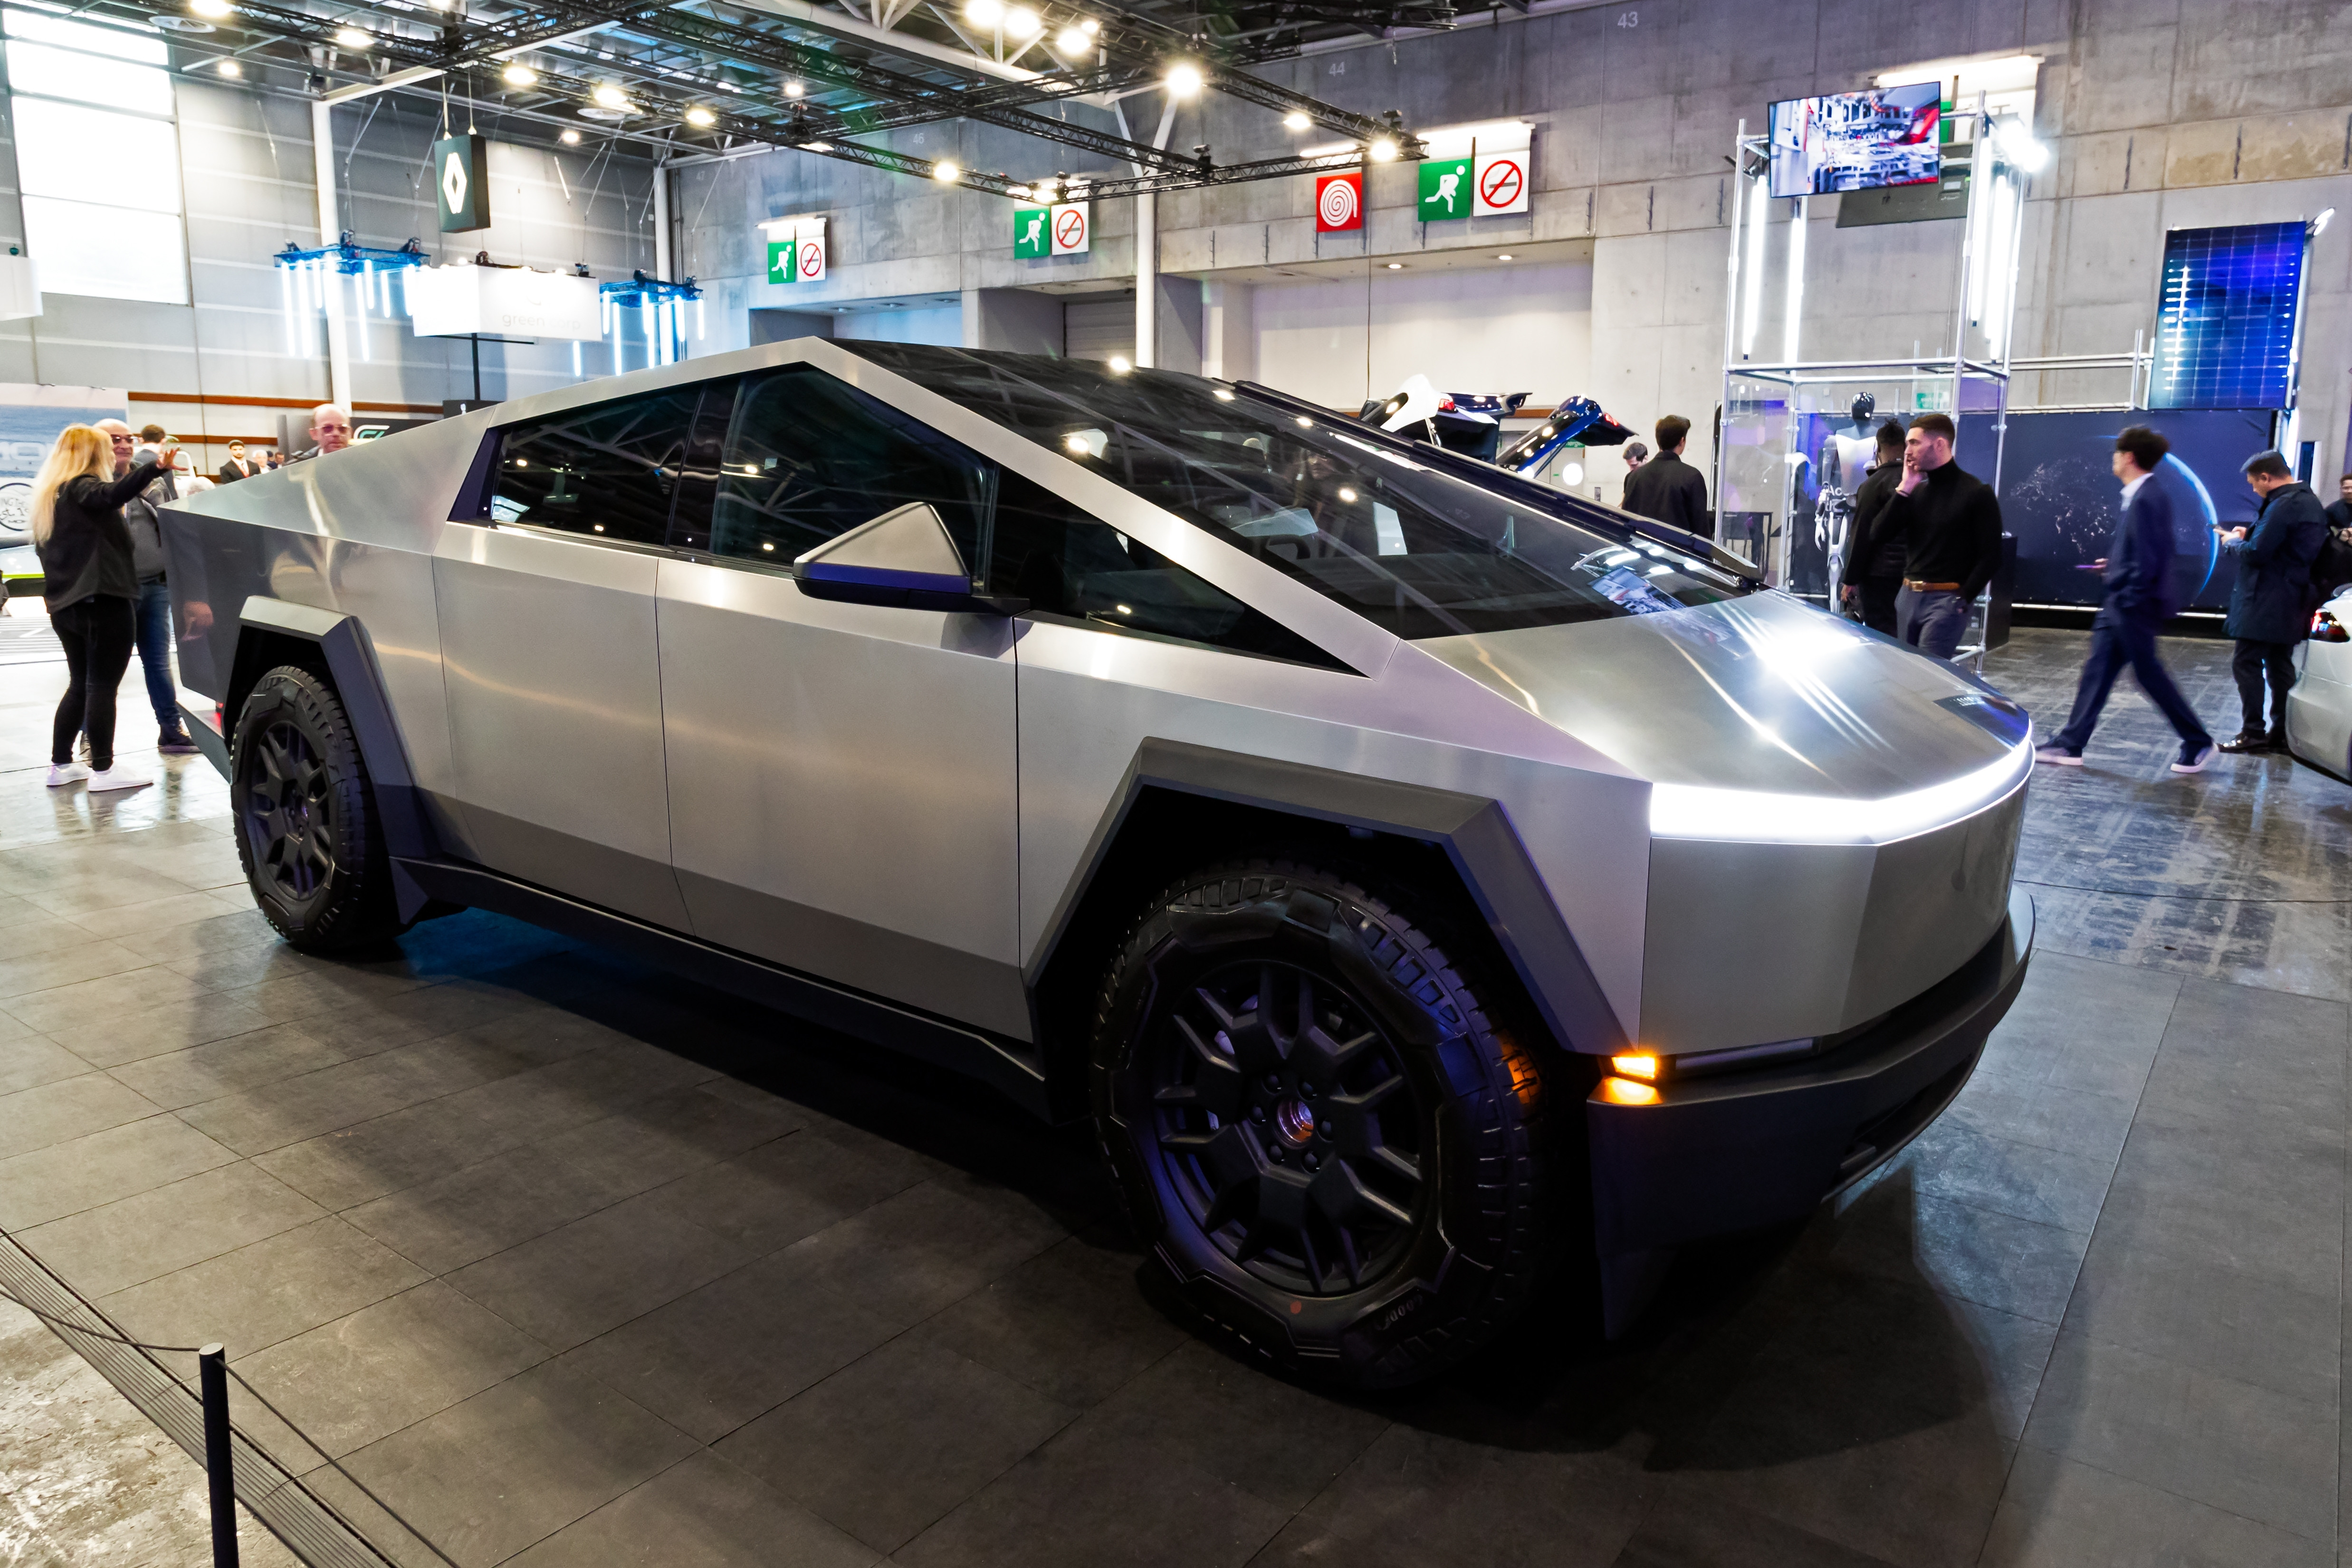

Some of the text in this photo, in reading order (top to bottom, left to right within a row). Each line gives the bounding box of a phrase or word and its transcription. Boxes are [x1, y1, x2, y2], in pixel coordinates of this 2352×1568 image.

[1617, 11, 1638, 29] 43
[1329, 62, 1346, 76] 44
[502, 314, 545, 327] green
